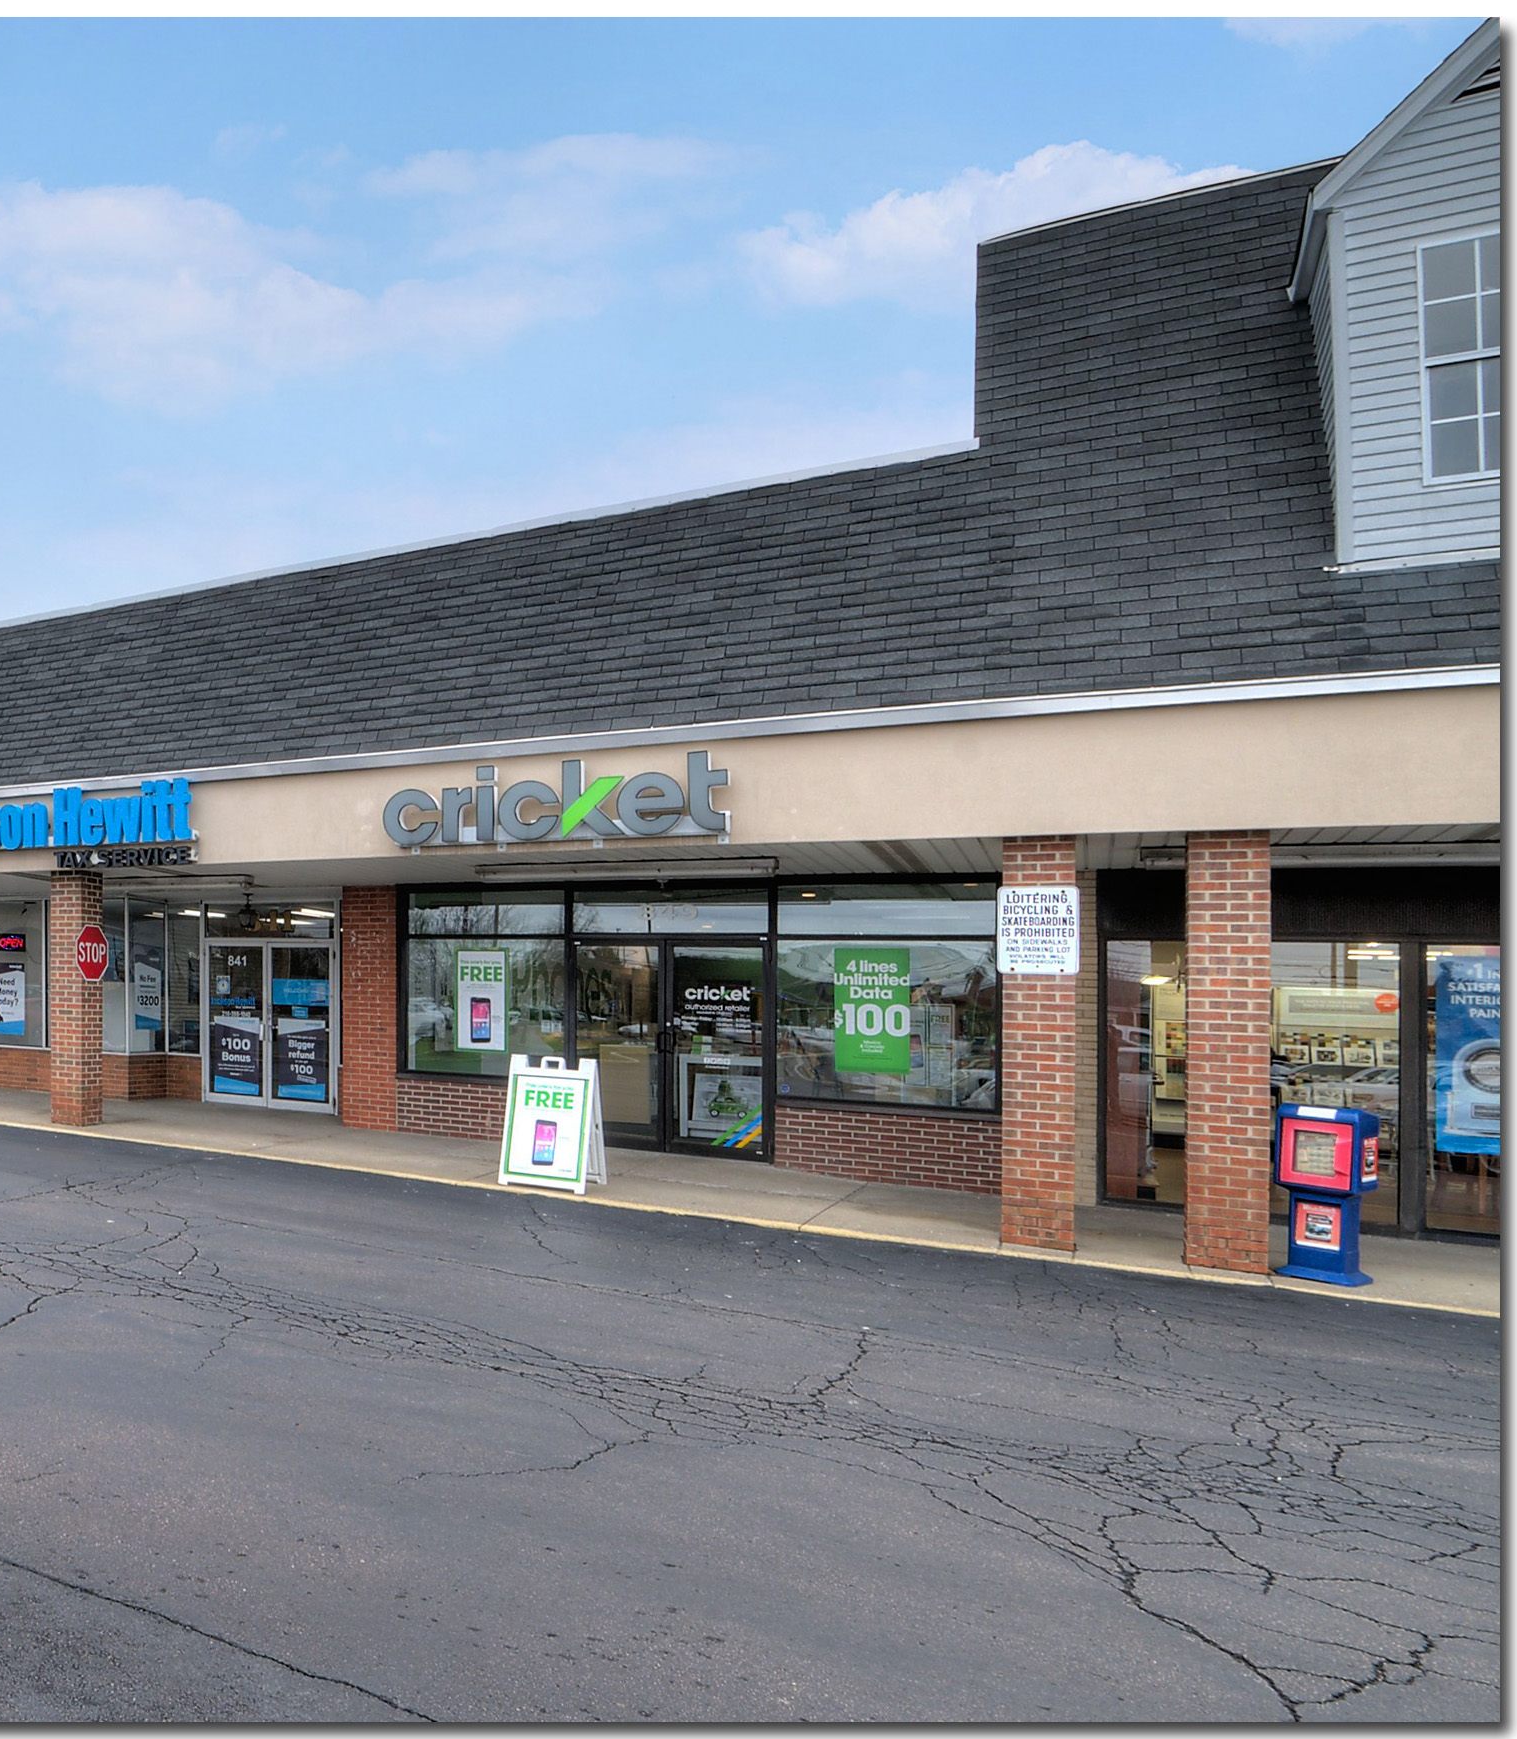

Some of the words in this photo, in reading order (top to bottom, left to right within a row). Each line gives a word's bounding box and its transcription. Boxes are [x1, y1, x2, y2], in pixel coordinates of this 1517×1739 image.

[383, 750, 729, 846] cricket
[53, 777, 193, 847] Hewitt
[53, 850, 93, 868] TAX
[97, 846, 192, 868] SERVICE
[639, 903, 699, 921] 849
[1003, 904, 1059, 915] BICYCLING
[1065, 904, 1073, 915] &
[1001, 916, 1075, 926] SKATEBOARDING
[1001, 927, 1011, 937] IS
[1014, 927, 1075, 938] PROHIBITED
[78, 942, 106, 963] STOP
[227, 955, 247, 967] 841
[846, 959, 857, 973] 4
[859, 960, 898, 973] lines
[460, 965, 503, 982] FREE
[834, 973, 910, 987] Unlimited
[684, 985, 751, 1001] cricket
[849, 986, 893, 1000] Data
[684, 1003, 723, 1011] authorized
[724, 1004, 750, 1012] retailer
[834, 1003, 910, 1037] $100
[221, 1037, 251, 1051] $100
[287, 1039, 315, 1050] Bigger
[221, 1051, 252, 1063] Bonus
[288, 1050, 315, 1060] refund
[290, 1064, 314, 1075] $100
[524, 1089, 575, 1110] FREE
